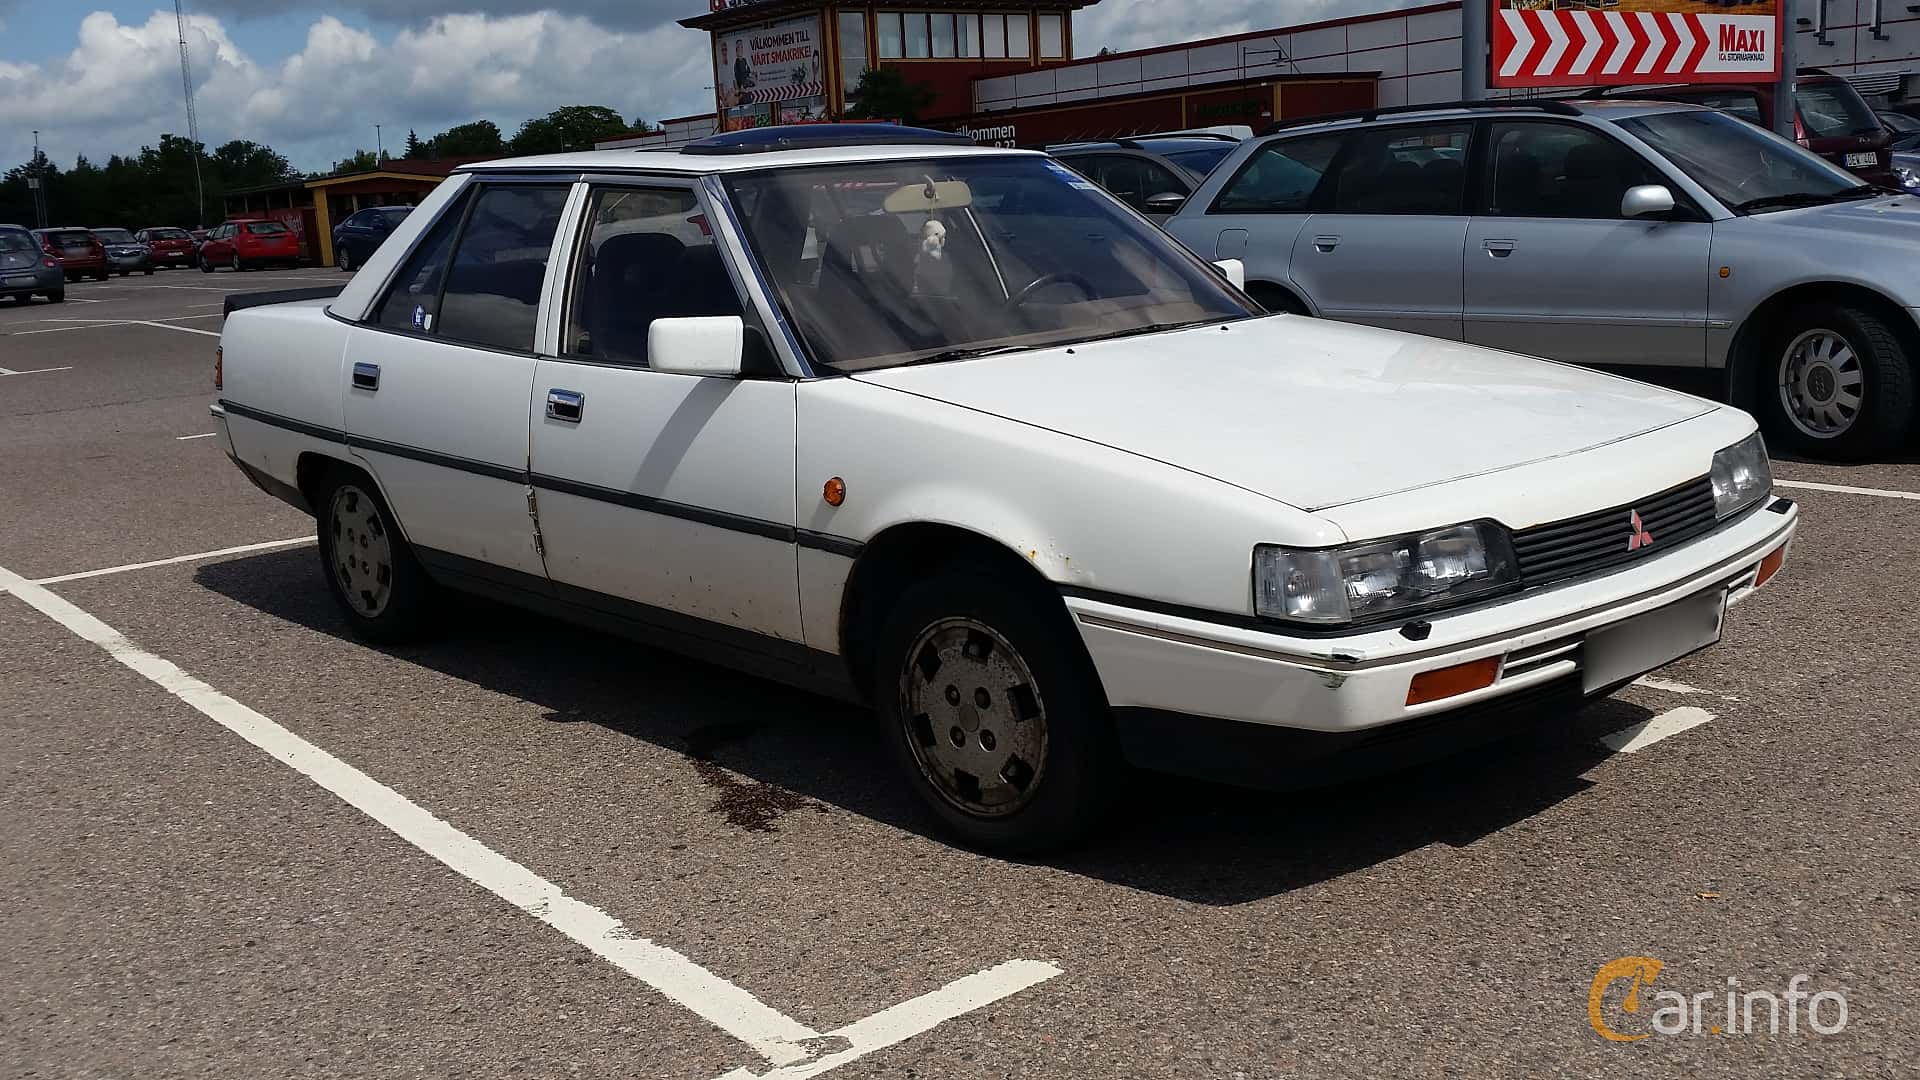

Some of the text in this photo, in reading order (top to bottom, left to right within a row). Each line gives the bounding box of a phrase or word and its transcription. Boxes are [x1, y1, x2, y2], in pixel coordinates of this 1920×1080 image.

[750, 30, 810, 50] VÄLKOMMEN TILL
[751, 46, 811, 65] VÅRT SMAKRIKE!
